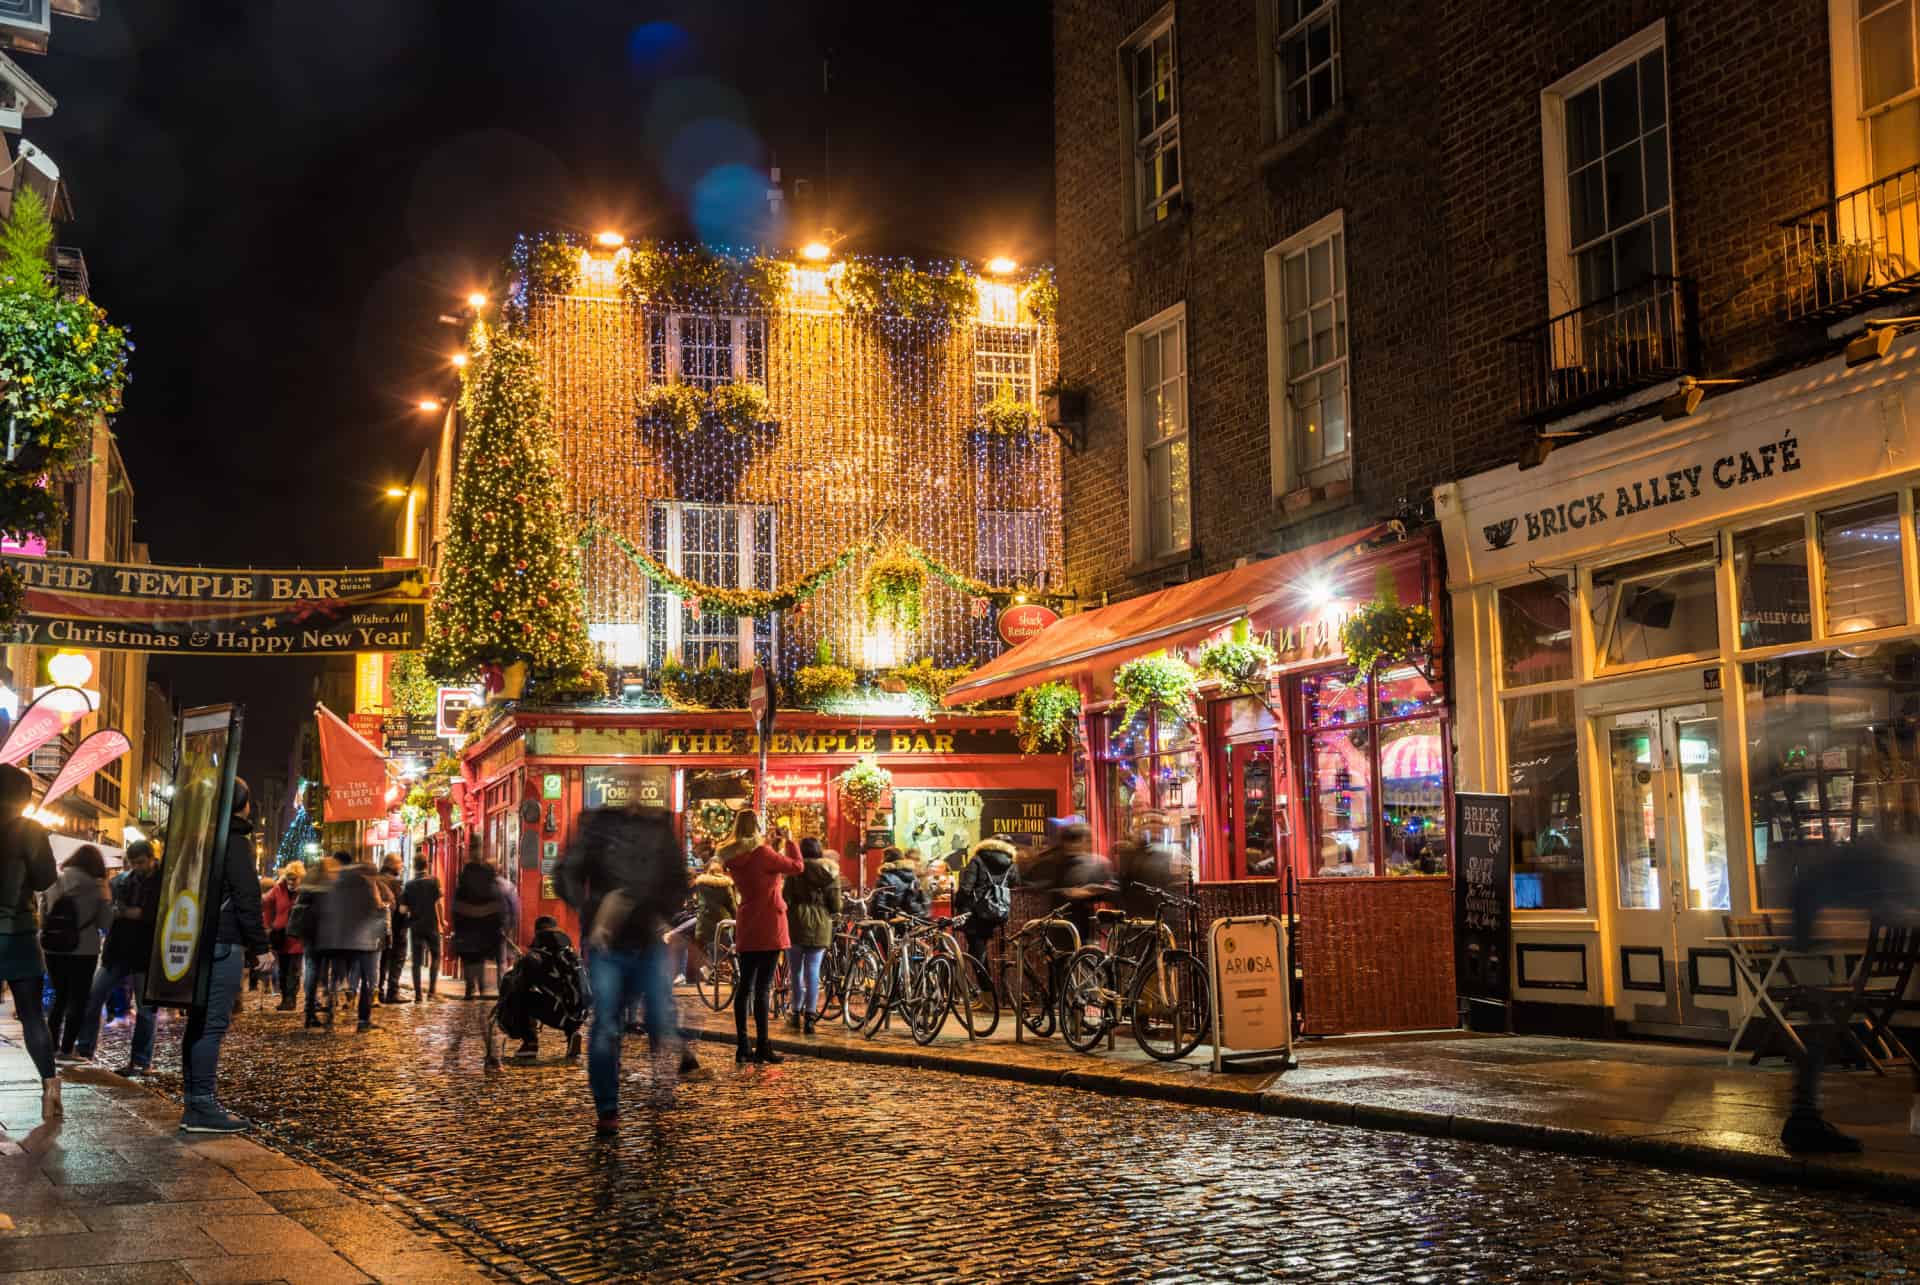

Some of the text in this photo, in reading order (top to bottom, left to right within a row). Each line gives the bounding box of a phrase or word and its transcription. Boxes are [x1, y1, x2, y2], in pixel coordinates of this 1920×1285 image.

[1526, 429, 1802, 541] BRICK ALLEY CAFÉ
[17, 561, 339, 600] THE TEMPLE BAR
[352, 612, 408, 624] Wishes All
[48, 620, 179, 647] Christmas
[189, 631, 209, 647] &
[216, 631, 294, 652] Happy
[303, 630, 352, 650] New
[359, 628, 411, 646] Year
[665, 734, 734, 753] THE
[890, 734, 954, 753] BAR
[335, 786, 381, 799] TEMPLE
[347, 797, 373, 808] BAR
[925, 795, 978, 807] TEMPLE
[940, 807, 967, 819] BAR
[1022, 803, 1045, 818] THE
[1464, 805, 1499, 823] BRICK
[993, 818, 1045, 834] EMPEROR
[1464, 821, 1501, 837] ALLEY
[1224, 956, 1274, 975] ARIOSA
